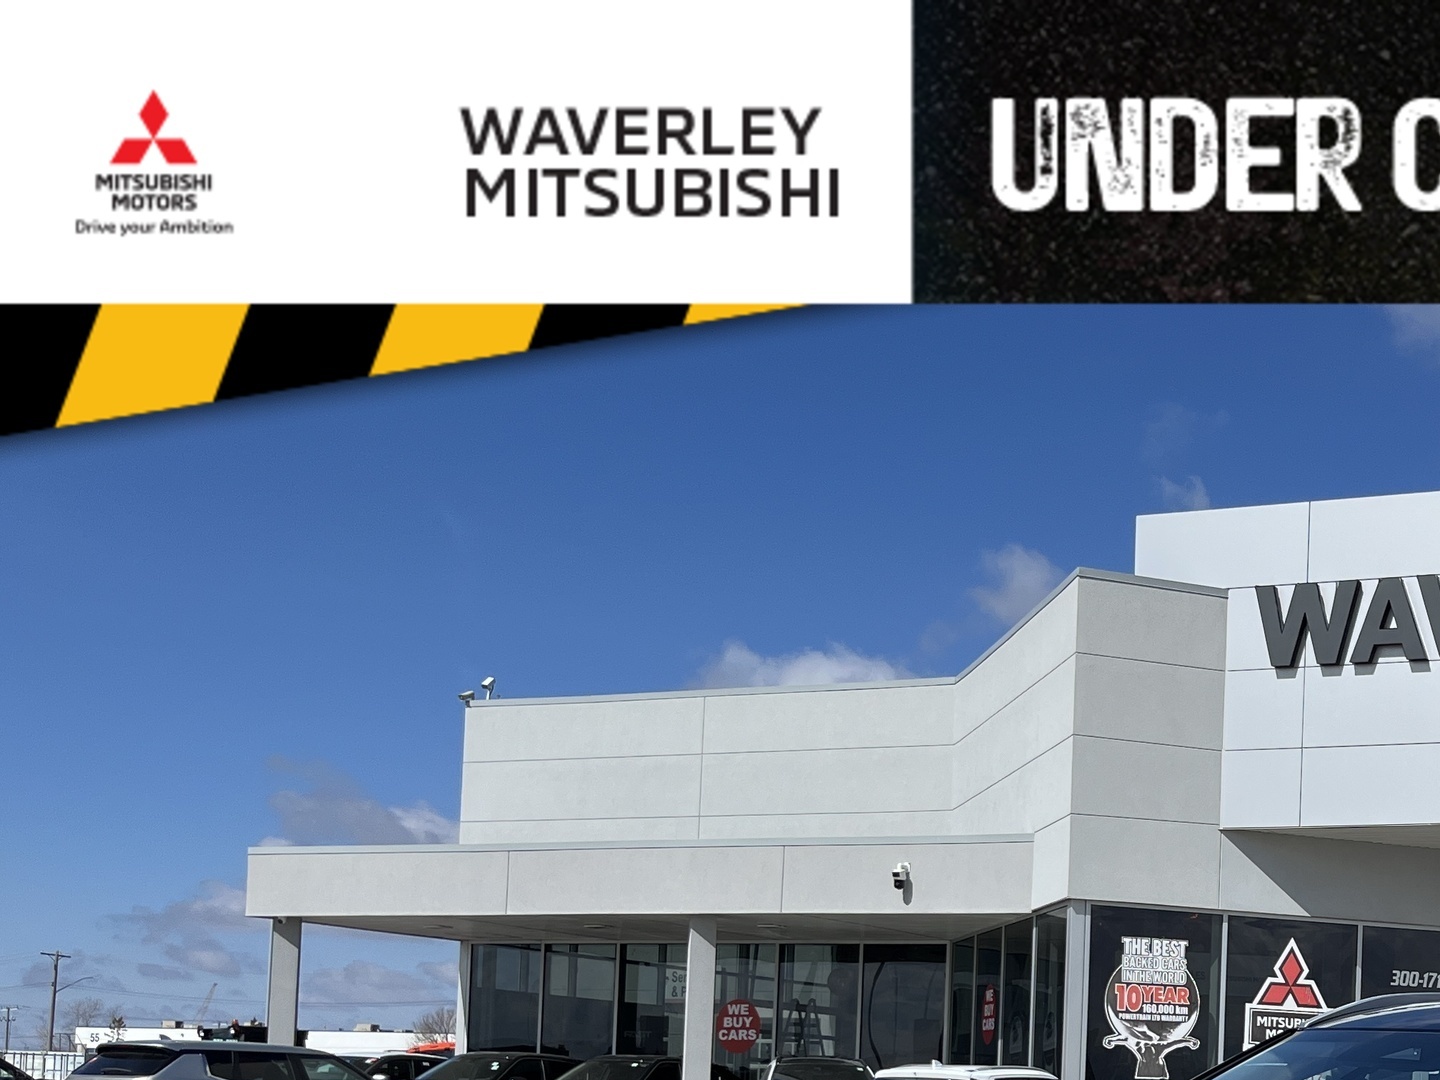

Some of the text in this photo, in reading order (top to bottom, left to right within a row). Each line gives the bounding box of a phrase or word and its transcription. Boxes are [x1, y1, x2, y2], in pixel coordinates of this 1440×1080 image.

[1121, 936, 1189, 958] THE BEST
[1122, 956, 1187, 971] BACKED CARS
[1122, 970, 1134, 982] IN
[1134, 970, 1152, 983] THE
[1152, 971, 1187, 985] WORLD
[1115, 983, 1190, 1012] 10 YEAR
[727, 1004, 749, 1015] WE
[1142, 1004, 1189, 1015] 160,000 km
[723, 1017, 753, 1028] BUY
[1256, 1015, 1308, 1030] MITSUB
[90, 1032, 100, 1043] 55
[718, 1029, 757, 1041] CARS
